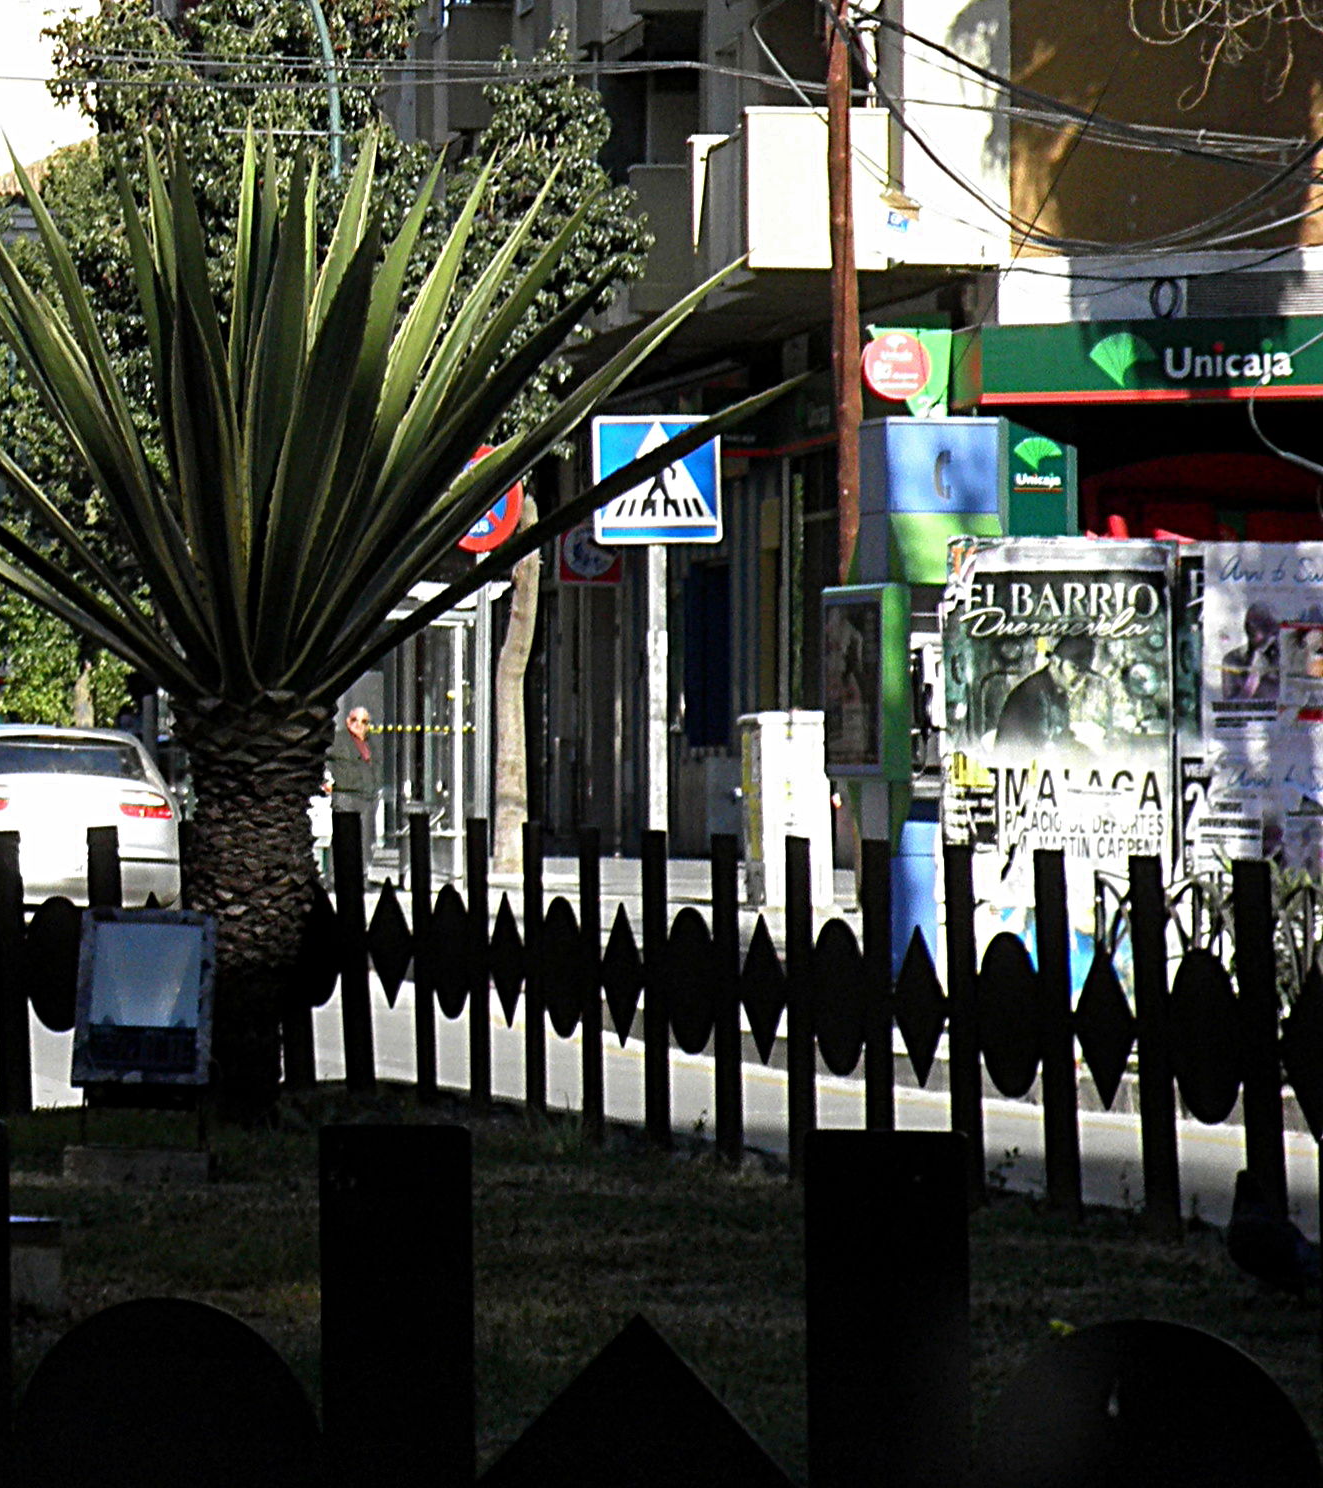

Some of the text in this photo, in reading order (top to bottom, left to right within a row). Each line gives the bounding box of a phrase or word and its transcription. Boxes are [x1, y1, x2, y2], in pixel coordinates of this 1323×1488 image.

[1164, 339, 1293, 385] Unicaja
[1014, 472, 1062, 489] Unicaja
[1011, 583, 1159, 618] BARRIO
[1005, 768, 1162, 811] MAGA
